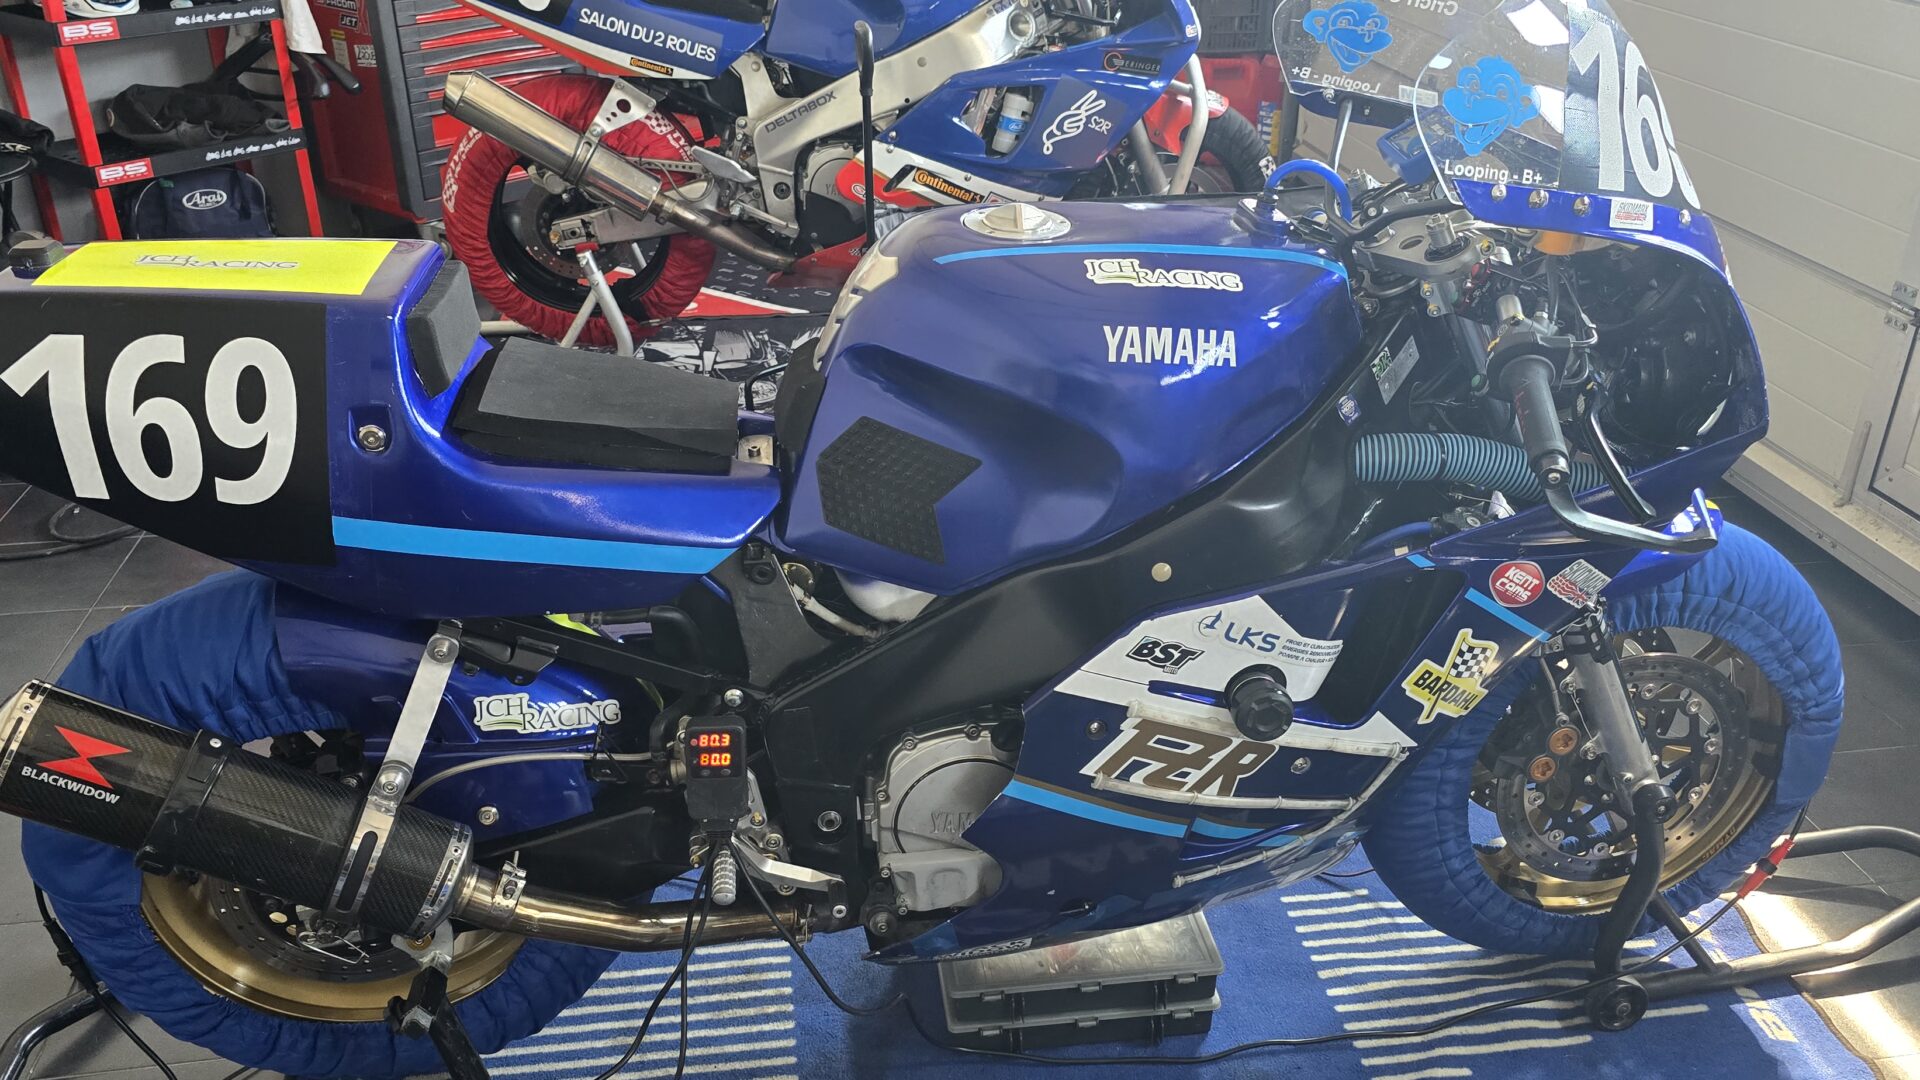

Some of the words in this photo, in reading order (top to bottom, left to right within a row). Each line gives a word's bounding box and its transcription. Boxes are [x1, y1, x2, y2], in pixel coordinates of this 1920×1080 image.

[62, 21, 113, 38] BS
[341, 15, 357, 26] JET
[579, 8, 630, 36] SALON
[631, 24, 654, 43] DU
[654, 31, 665, 47] 2
[665, 34, 716, 62] ROUES
[764, 90, 837, 133] DELTABOX
[1088, 116, 1112, 134] S2R
[100, 162, 147, 180] BS
[1444, 159, 1509, 184] Looping
[1522, 168, 1543, 185] B+
[187, 191, 223, 206] Arai
[914, 169, 974, 202] Continental
[137, 254, 193, 263] JCH
[183, 259, 299, 269] RACING
[1090, 261, 1138, 276] JCH
[1135, 271, 1240, 289] RACING
[1103, 325, 1237, 367] YAMAHA
[0, 333, 298, 505] 169
[1505, 566, 1540, 590] KENT
[1224, 621, 1280, 653] LKS
[1131, 639, 1201, 667] BST
[1413, 669, 1478, 711] BARDAHL
[476, 696, 523, 723] JCH
[521, 703, 620, 731] RACING
[699, 733, 731, 747] 80.3
[700, 753, 731, 766] 80.0
[21, 766, 121, 804] BLACKWIDOW
